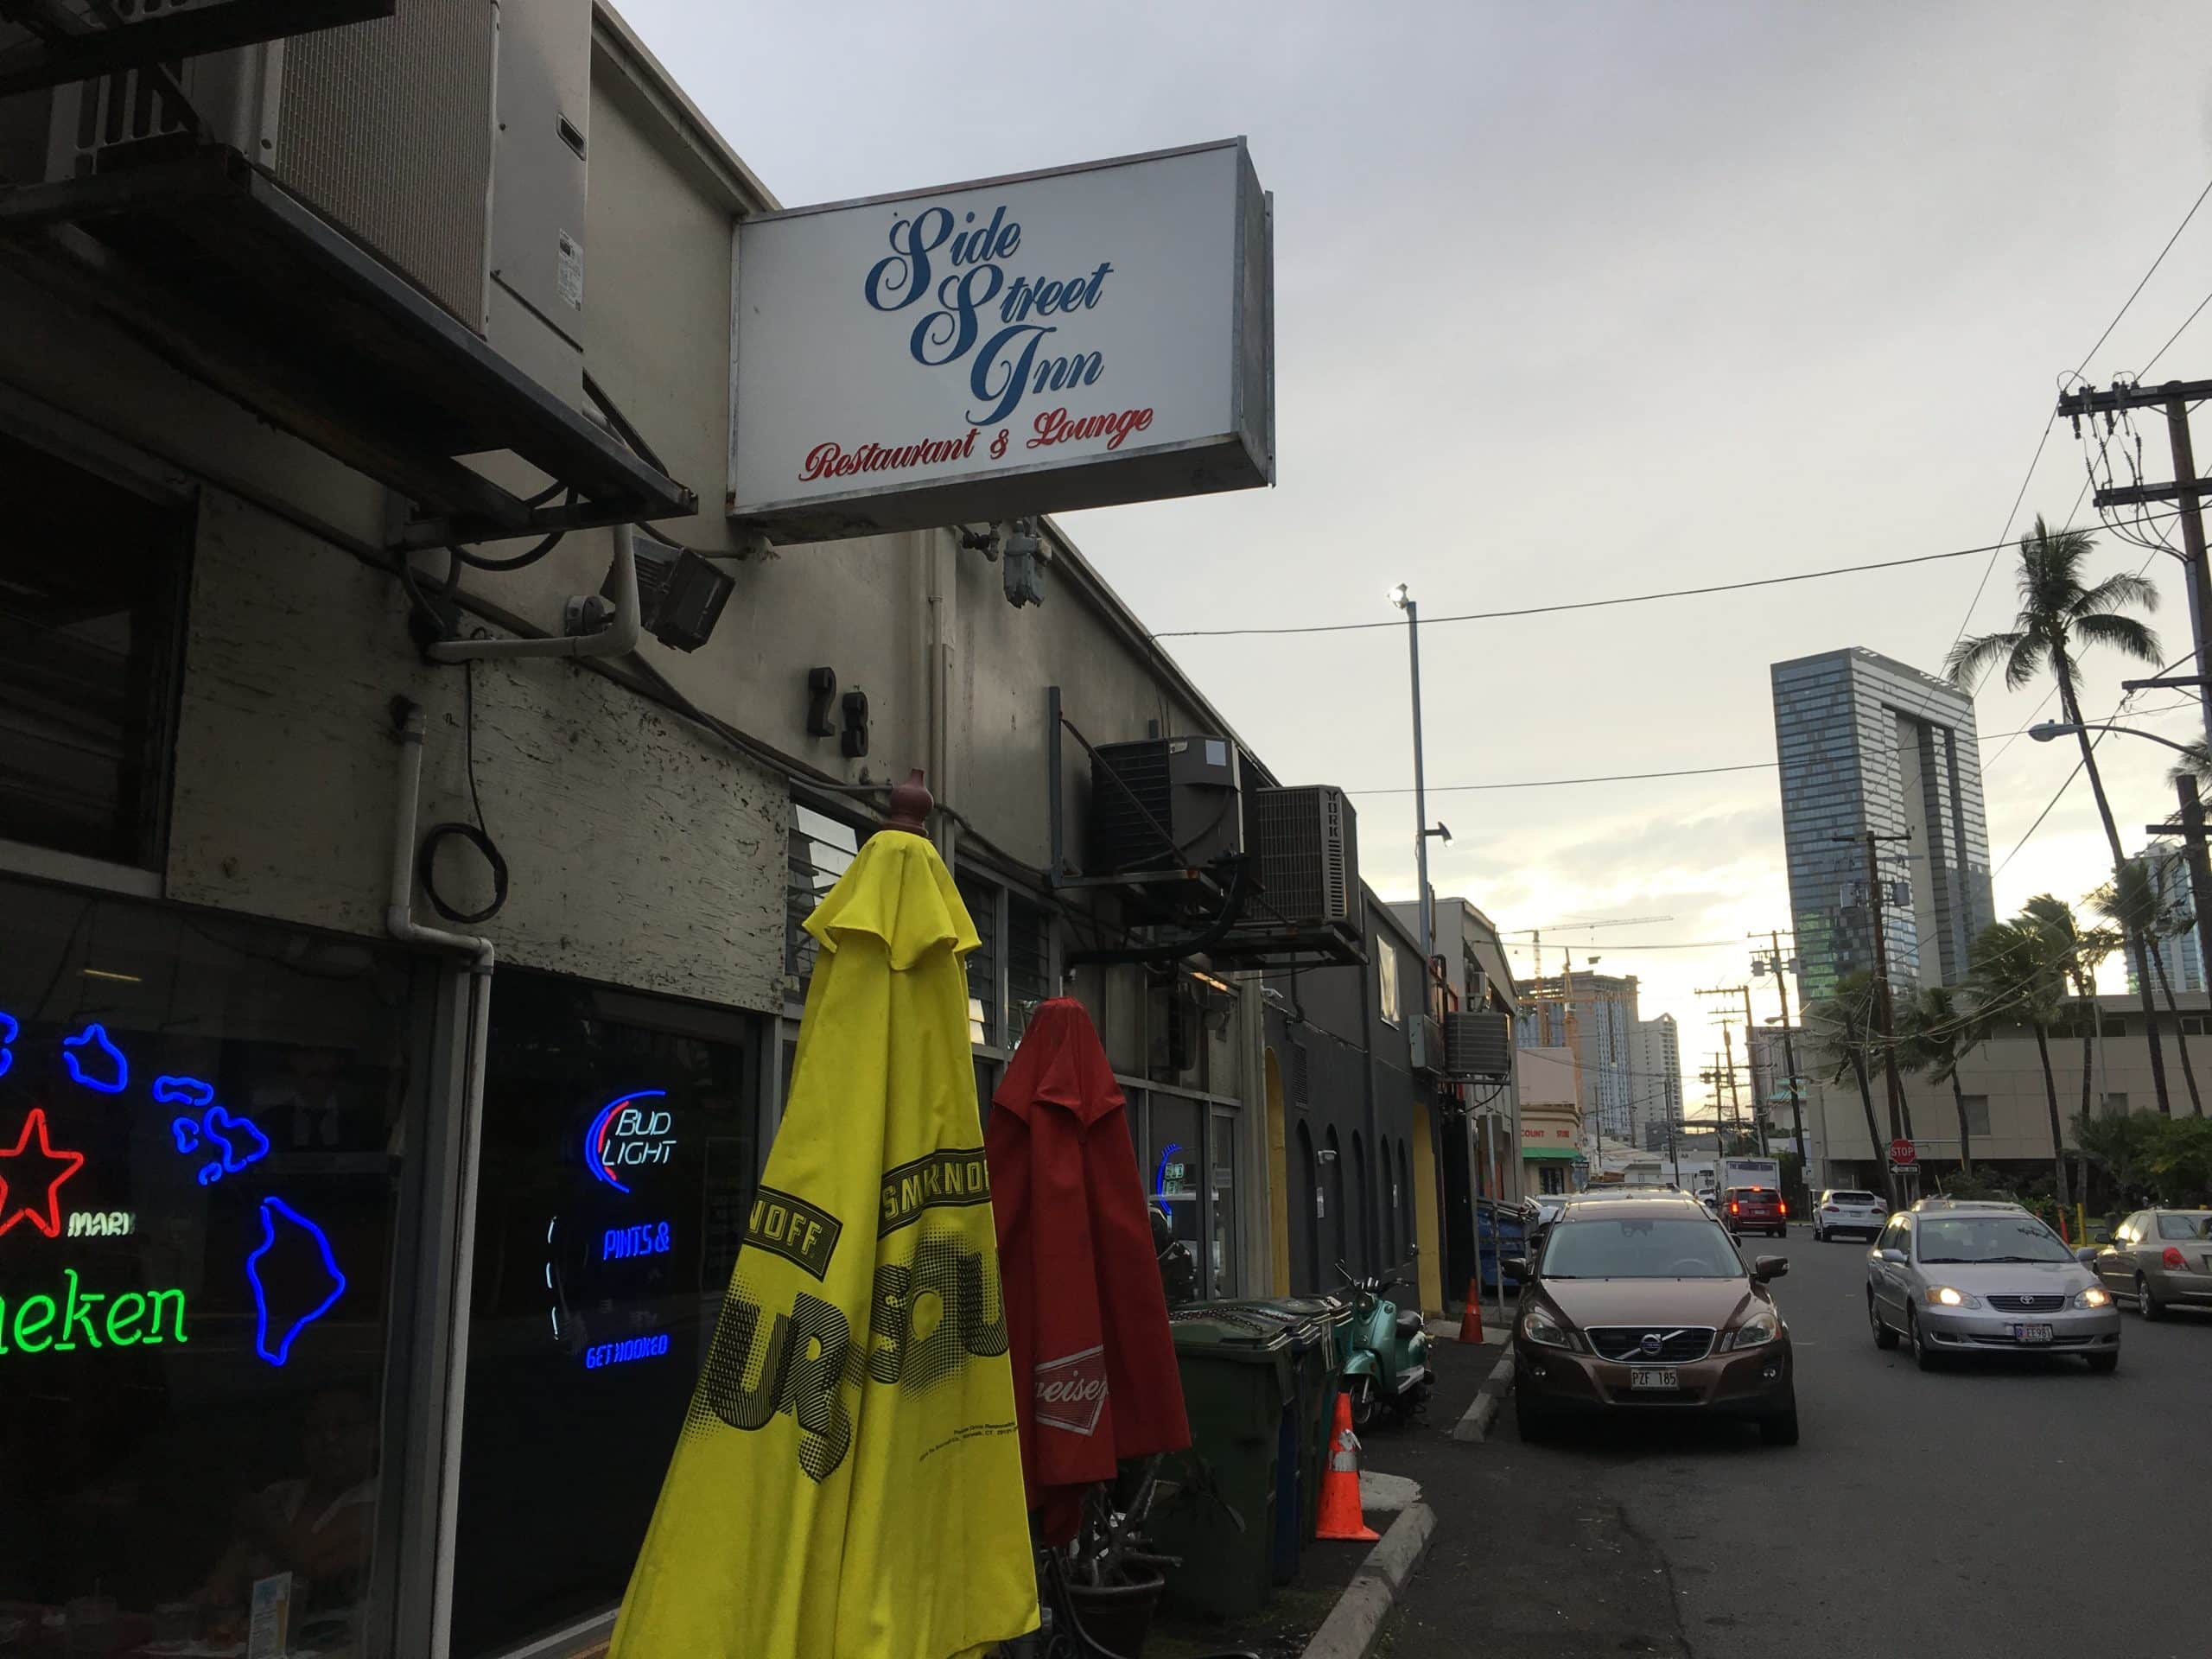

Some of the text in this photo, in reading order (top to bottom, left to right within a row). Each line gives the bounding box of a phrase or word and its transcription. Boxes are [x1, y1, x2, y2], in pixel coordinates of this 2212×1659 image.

[865, 206, 1021, 311] Side
[910, 262, 1115, 366] Street
[965, 324, 1105, 426] Inn
[798, 407, 1154, 482] Restaurant & Lounge
[1325, 790, 1338, 837] YORK
[615, 1109, 671, 1136] BUD
[602, 1140, 677, 1166] LIGHT
[1891, 1147, 1914, 1156] STOP
[587, 1344, 613, 1369] GET
[1632, 1371, 1676, 1385] PZF 185
